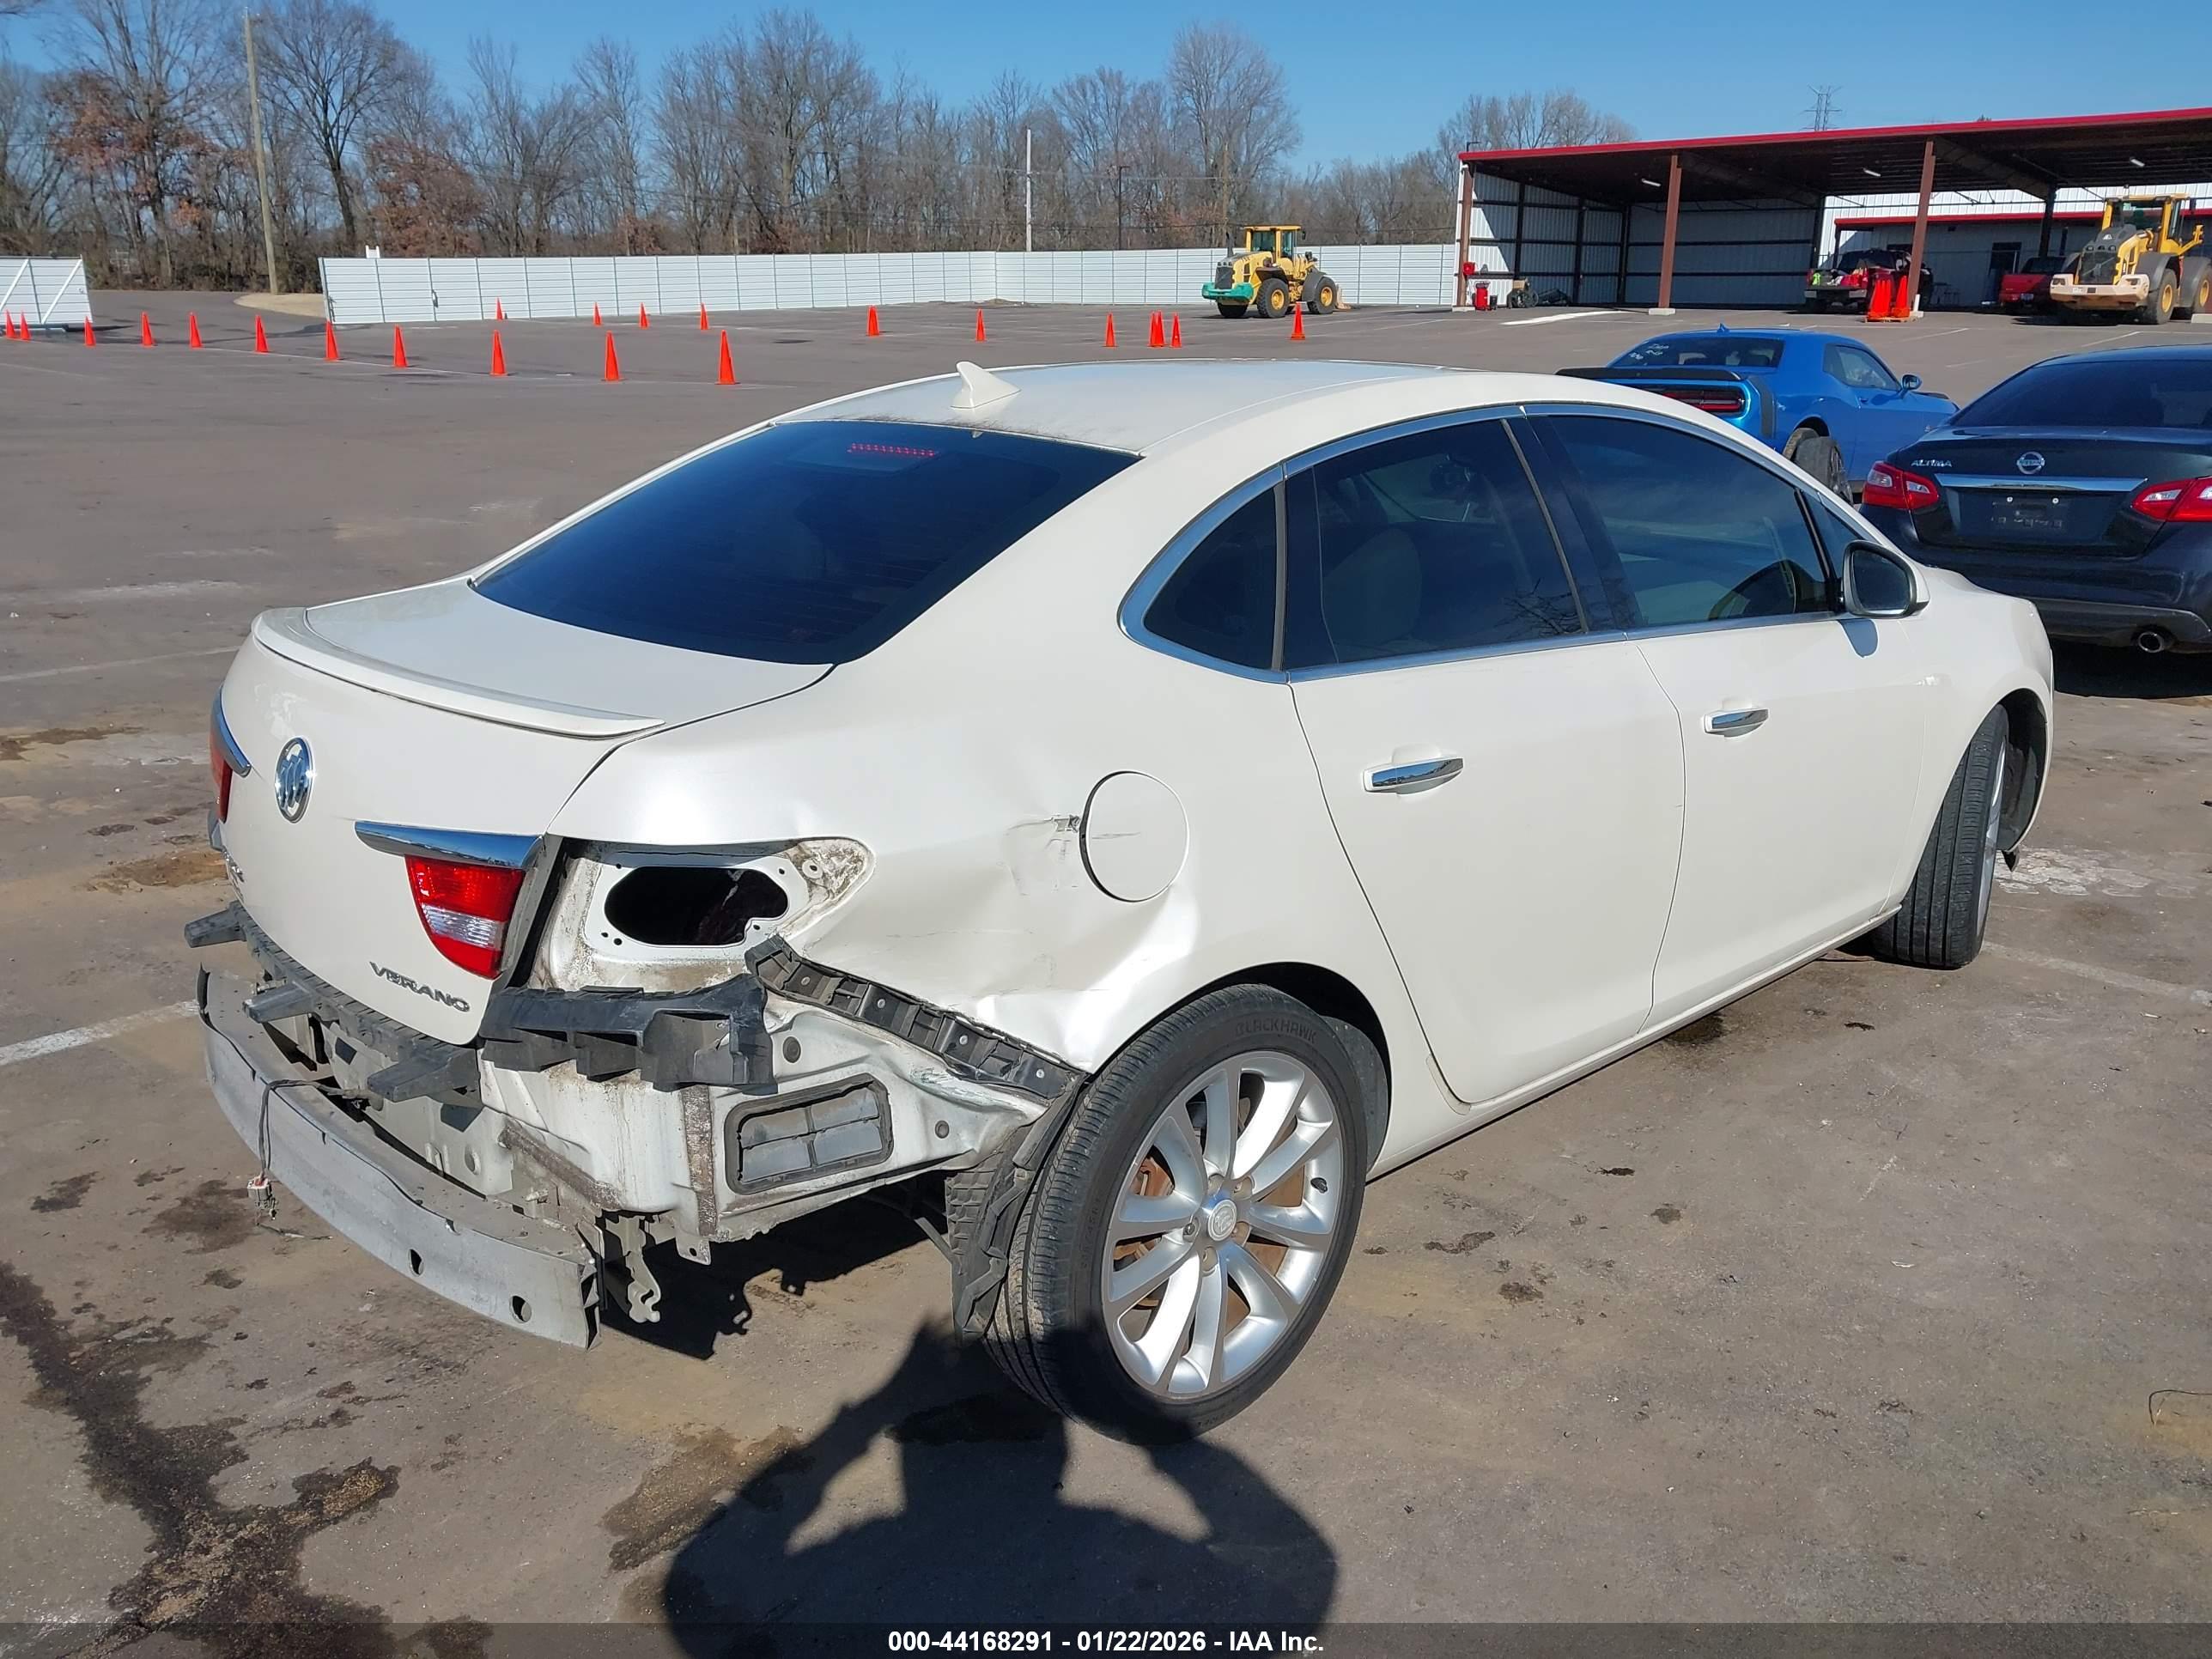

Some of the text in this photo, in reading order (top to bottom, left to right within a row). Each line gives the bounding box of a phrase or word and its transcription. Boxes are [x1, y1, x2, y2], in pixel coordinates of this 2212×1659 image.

[1911, 459, 1953, 468] ALTIMA
[369, 961, 471, 1012] VERANO
[1235, 1017, 1317, 1045] BLACKHAWK
